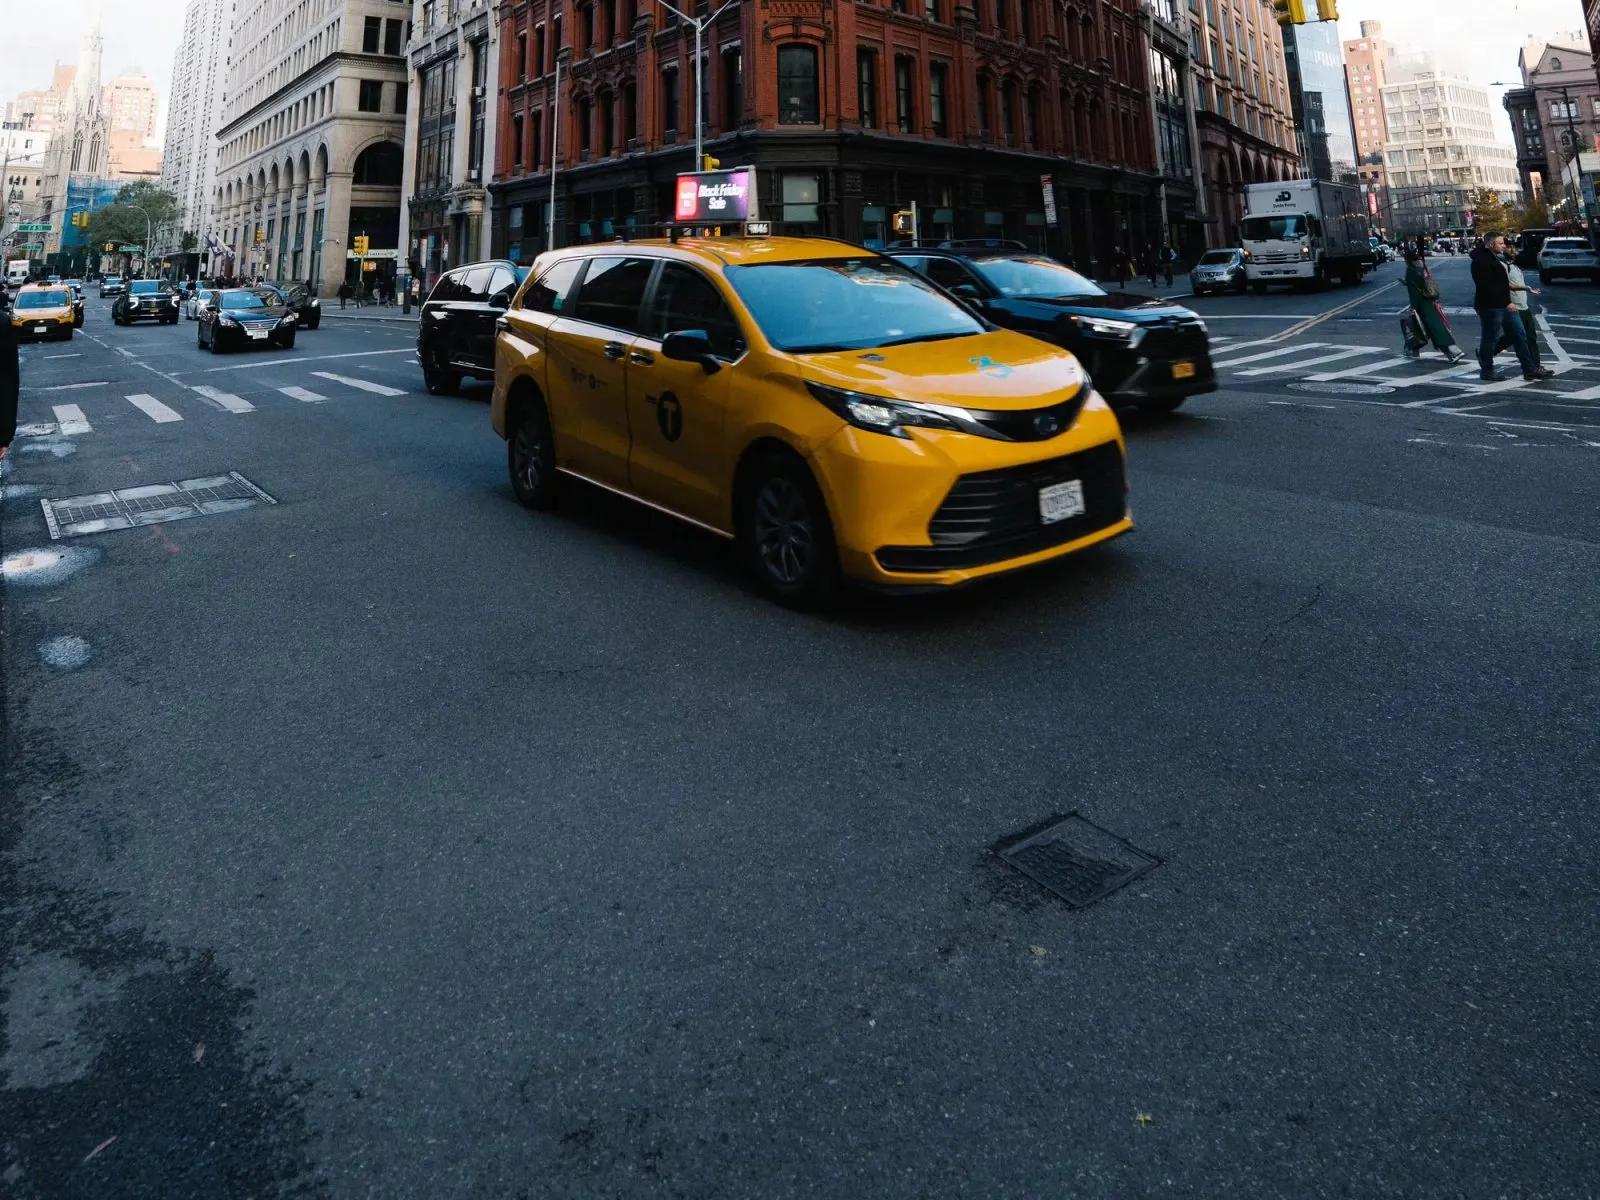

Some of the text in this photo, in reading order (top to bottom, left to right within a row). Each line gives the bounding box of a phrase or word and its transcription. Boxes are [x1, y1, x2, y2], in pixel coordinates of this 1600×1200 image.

[698, 183, 745, 198] Black Friday
[708, 197, 726, 210] Sale
[663, 400, 676, 435] T
